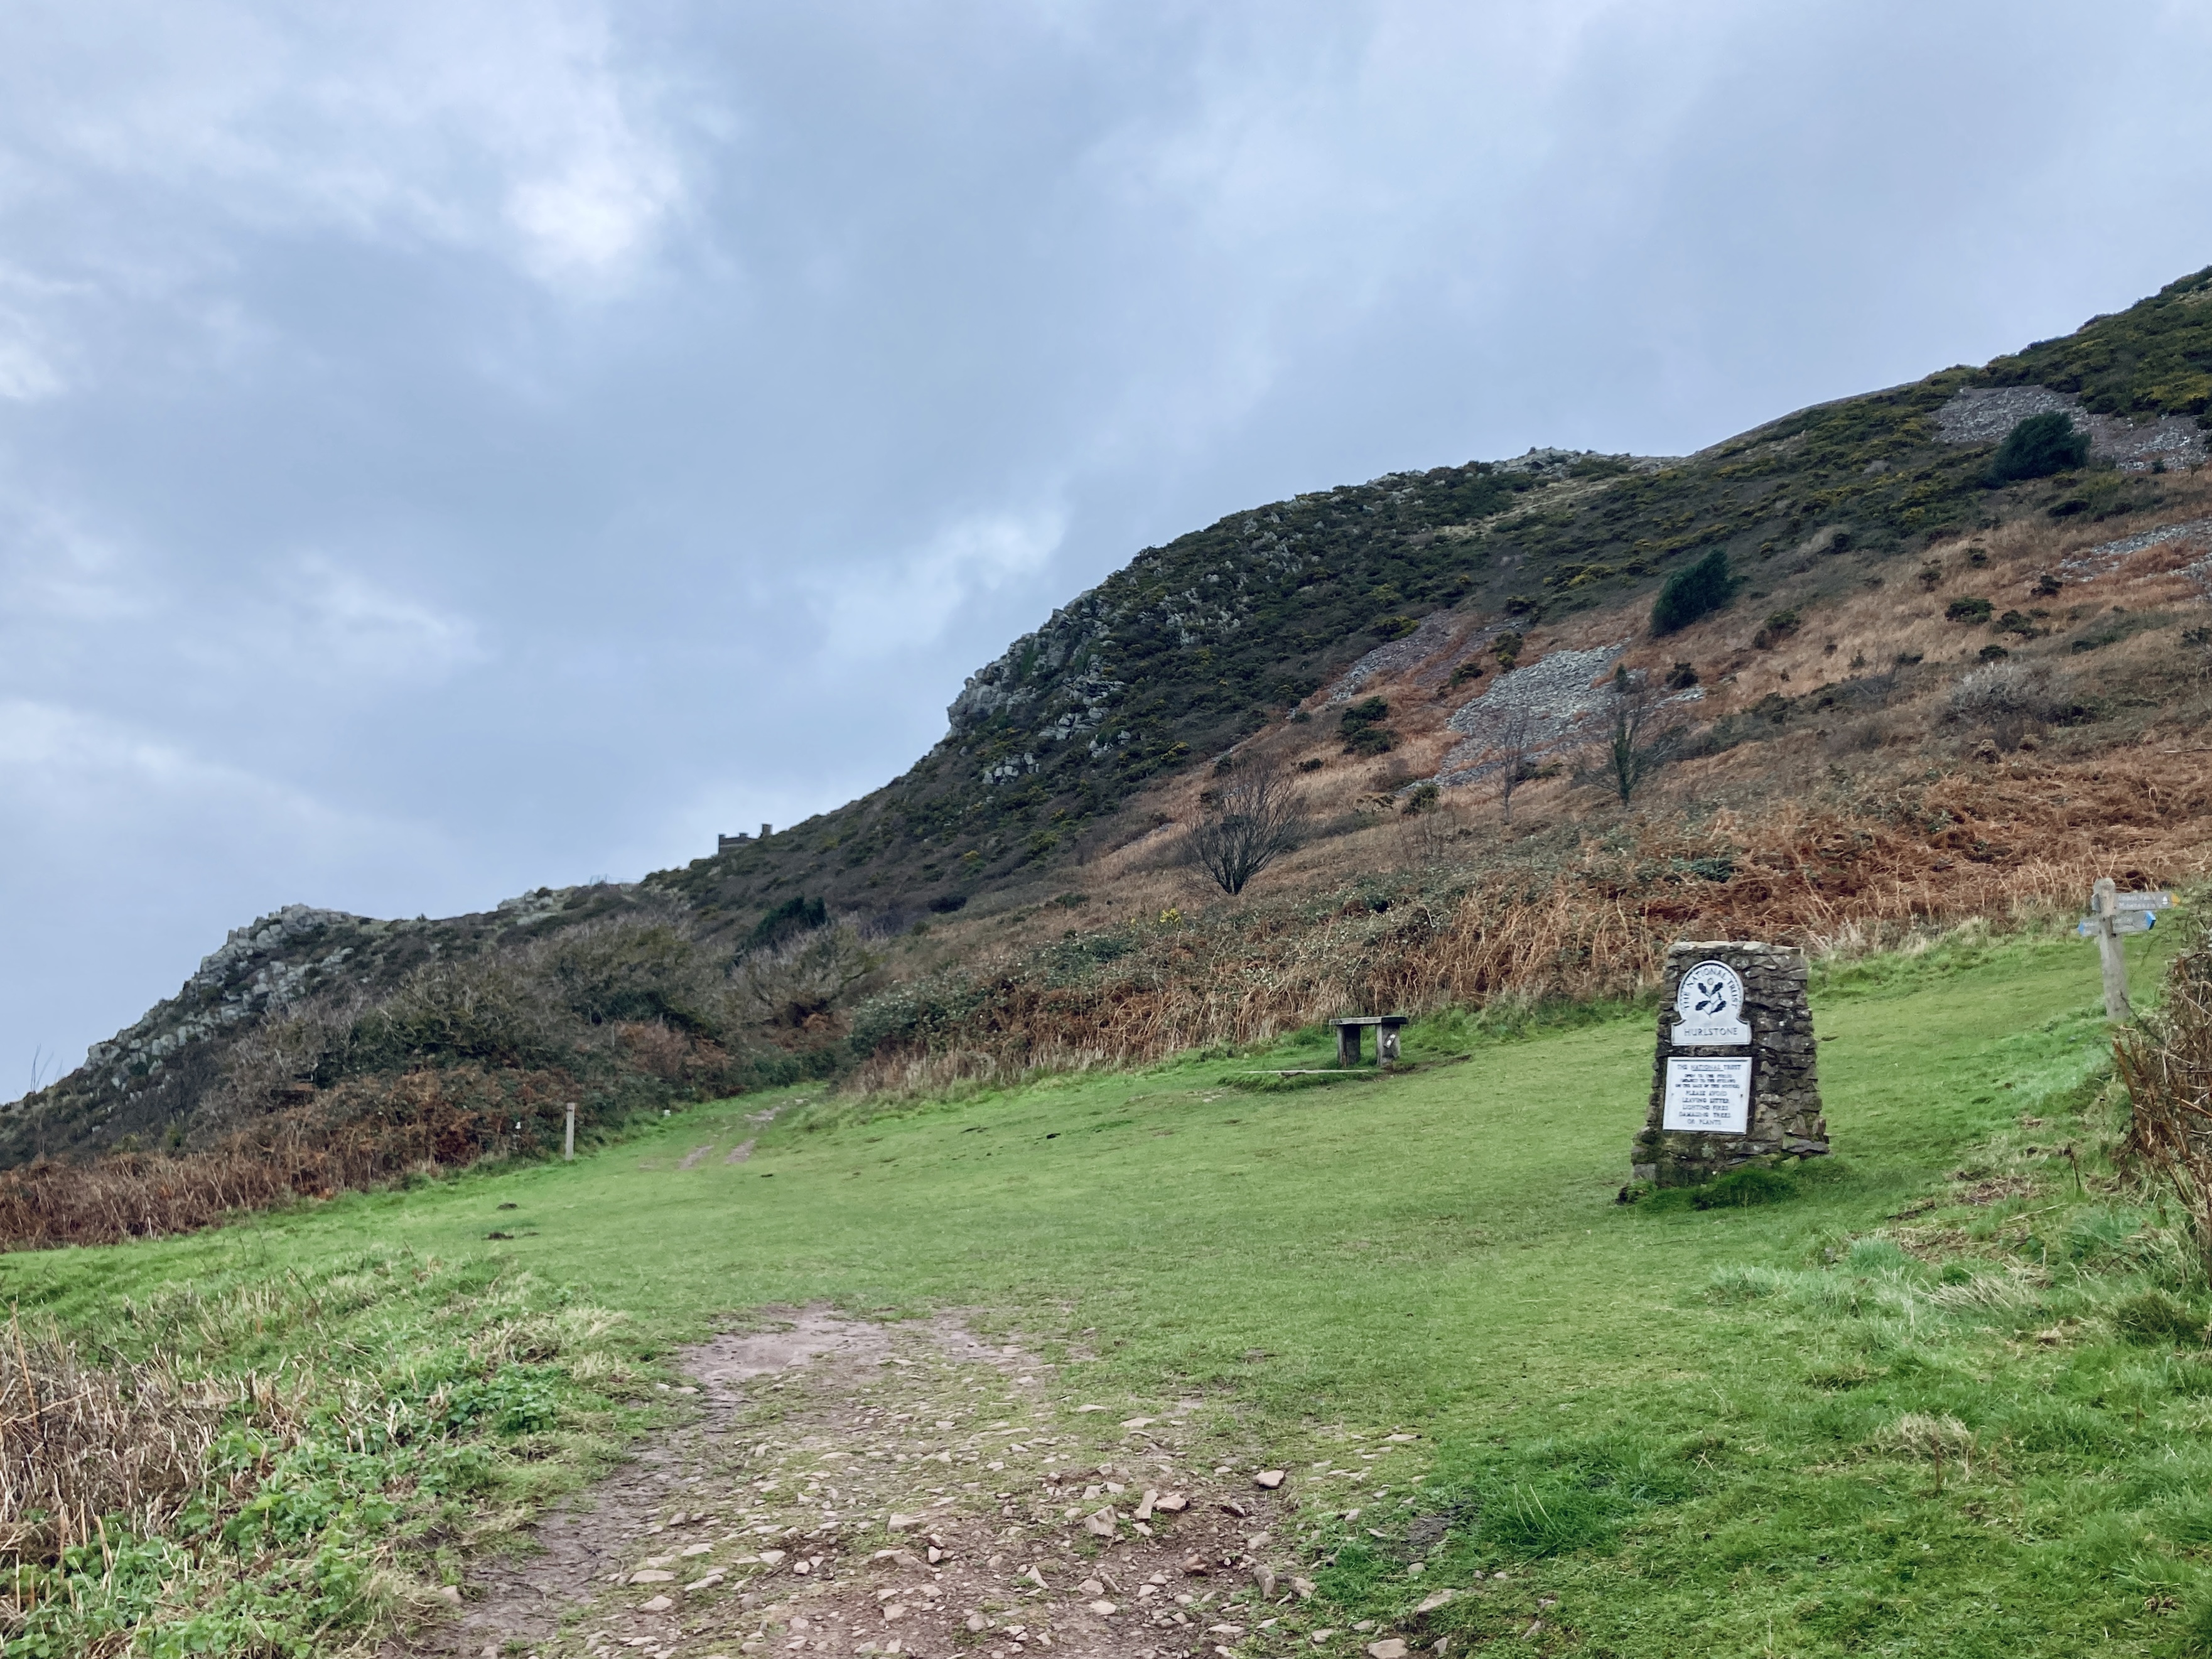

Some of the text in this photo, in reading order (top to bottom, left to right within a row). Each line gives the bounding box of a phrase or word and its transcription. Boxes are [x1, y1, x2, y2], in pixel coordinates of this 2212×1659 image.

[1686, 968, 1727, 988] NATIONAL
[1727, 978, 1738, 1007] TRUST
[1684, 1027, 1738, 1036] HURLSTONE
